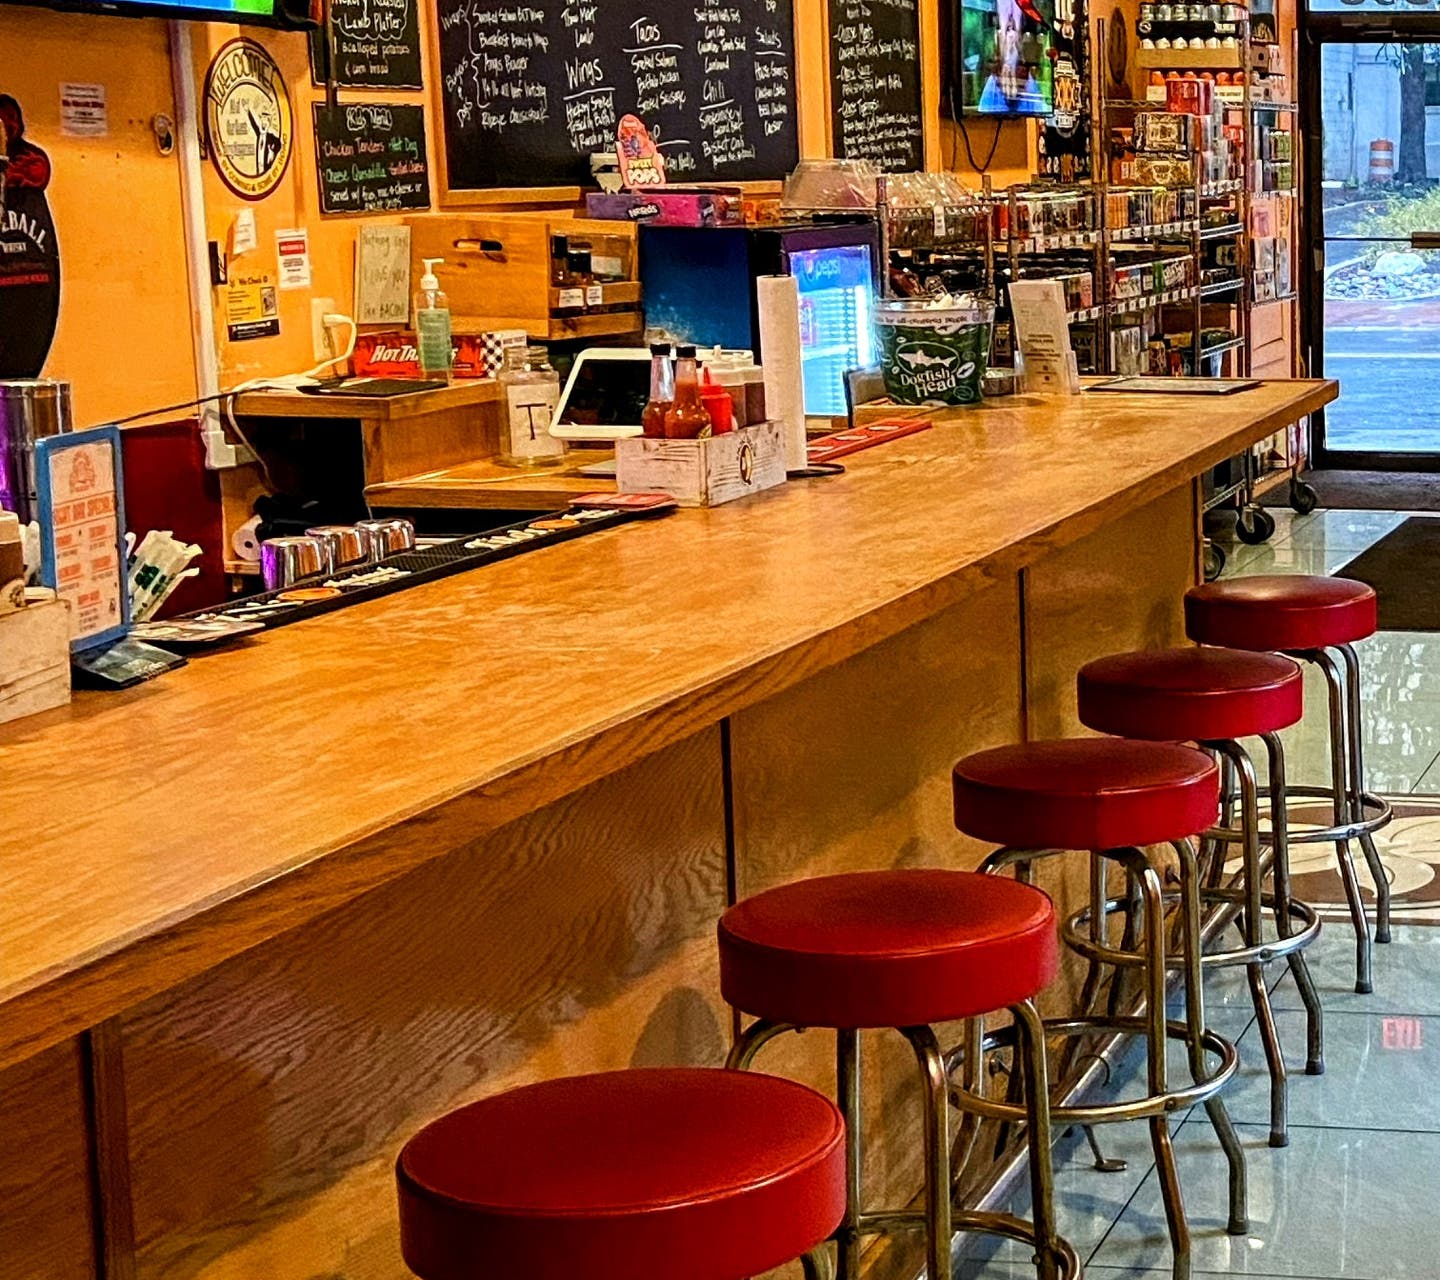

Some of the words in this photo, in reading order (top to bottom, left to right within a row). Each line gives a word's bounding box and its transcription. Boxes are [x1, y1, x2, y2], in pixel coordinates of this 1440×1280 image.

[344, 13, 371, 29] Lamb
[629, 17, 660, 44] Tacos
[565, 56, 604, 90] Wings
[901, 367, 950, 386] Dogfish
[914, 374, 957, 398] Head
